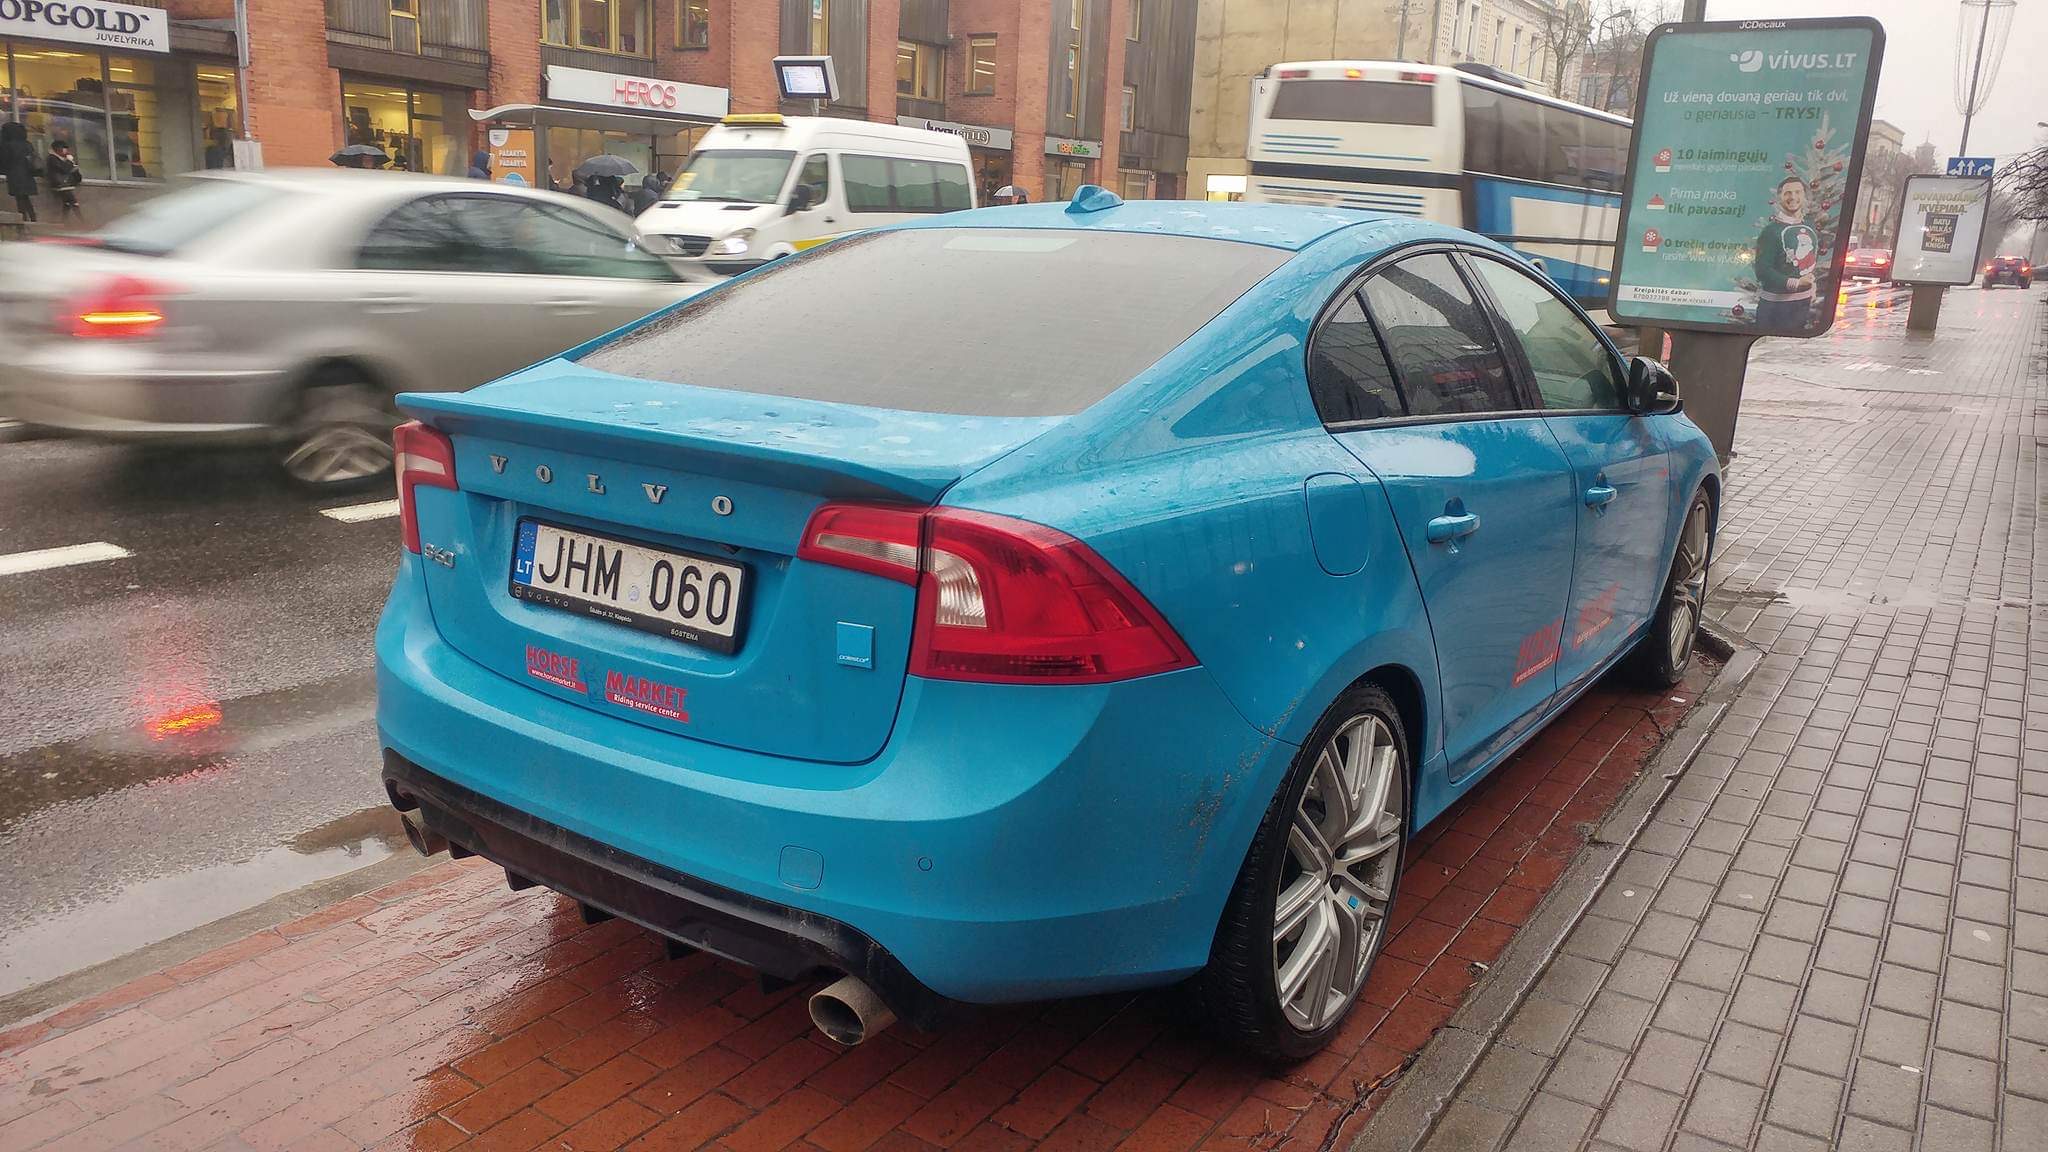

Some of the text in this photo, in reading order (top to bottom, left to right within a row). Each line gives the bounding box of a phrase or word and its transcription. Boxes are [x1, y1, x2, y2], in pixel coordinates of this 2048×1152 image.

[1739, 20, 1787, 30] JCDecaux
[96, 33, 155, 47] JUVELYRIKA
[612, 79, 677, 109] HEROS
[1663, 91, 1679, 103] Už
[1682, 90, 1713, 105] vieną
[1716, 89, 1760, 104] dovaną
[1763, 90, 1803, 104] geriau
[1808, 89, 1824, 101] tik
[1695, 107, 1757, 123] geriausia
[1775, 106, 1821, 121] TRYS!
[1677, 149, 1694, 161] 10
[1670, 187, 1700, 200] Pirma
[1668, 202, 1683, 214] tik
[489, 454, 734, 517] VOLVO
[516, 558, 532, 574] LT
[538, 536, 732, 626] JHM 060
[528, 591, 569, 607] VOLVO
[670, 628, 698, 641] SOSTENA
[527, 644, 579, 679] HORSE
[606, 670, 688, 711] MARKET
[614, 693, 680, 719] Riding service center
